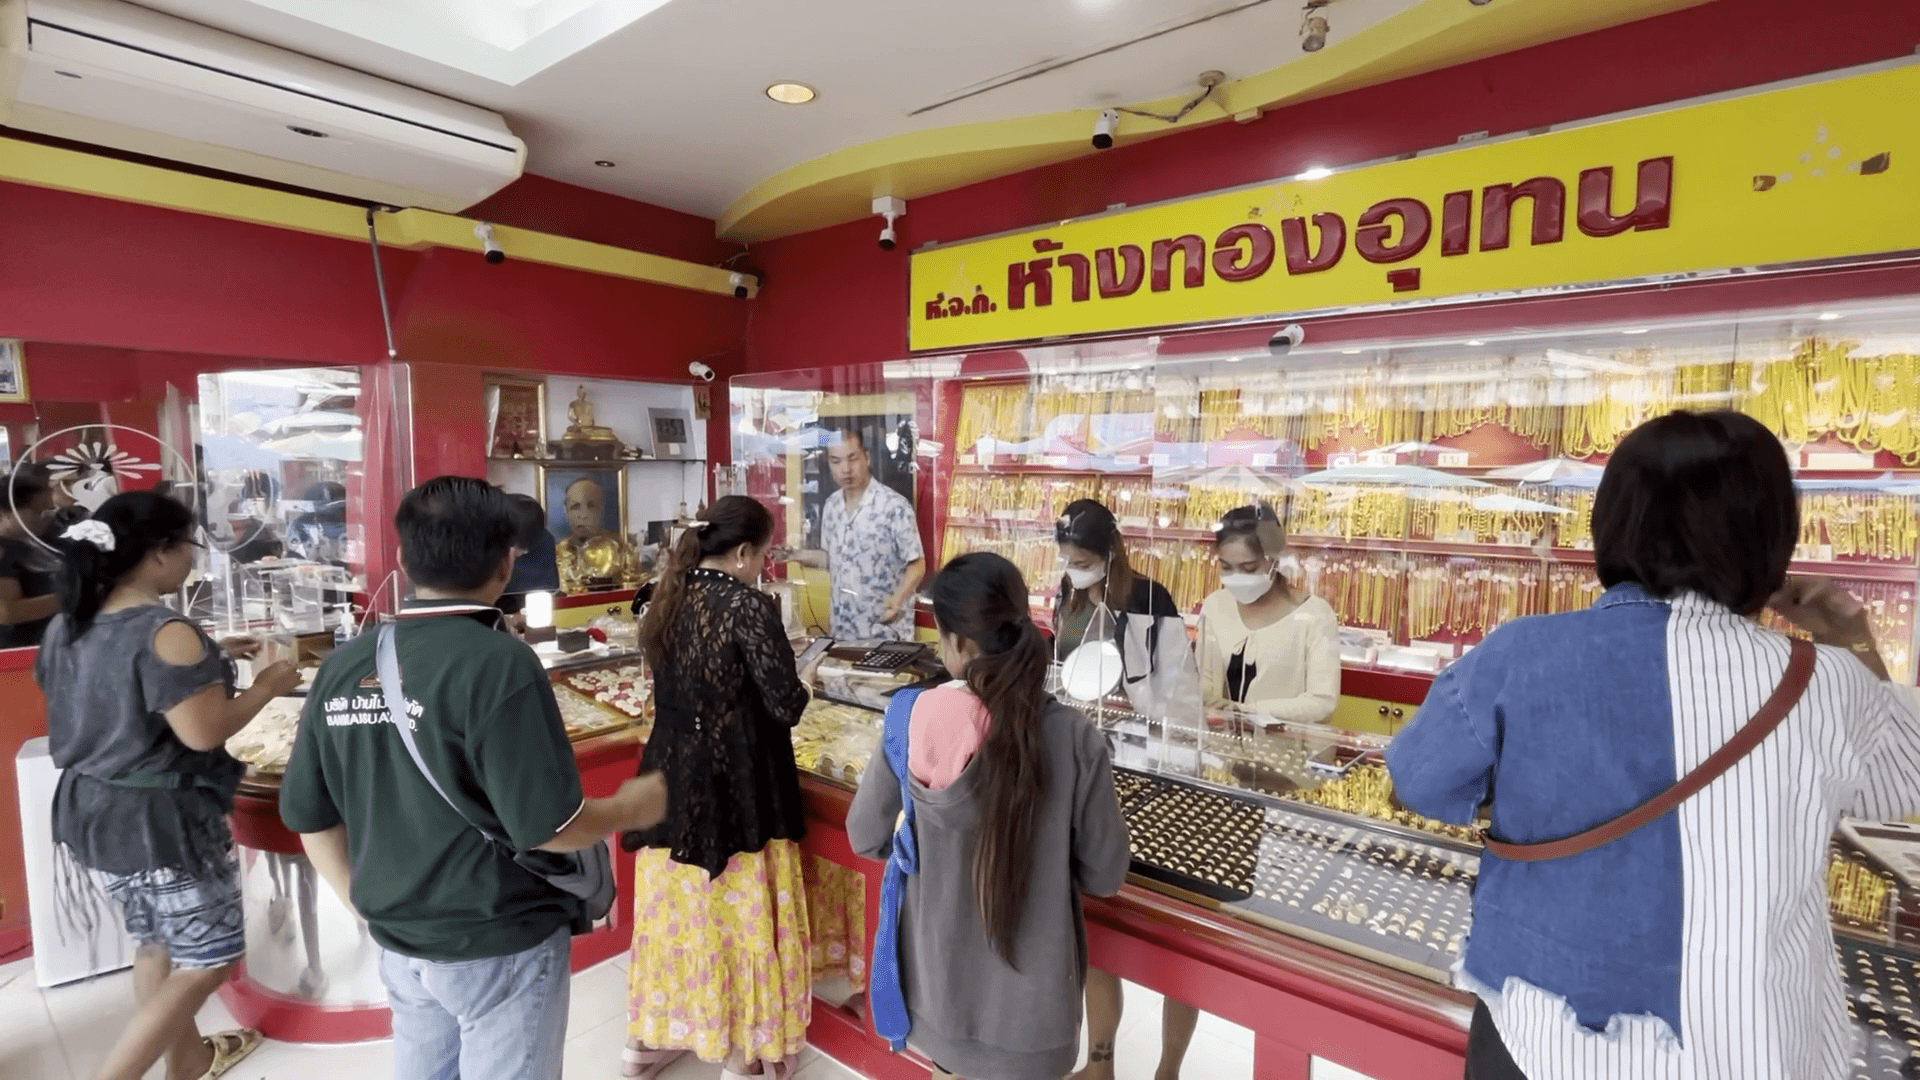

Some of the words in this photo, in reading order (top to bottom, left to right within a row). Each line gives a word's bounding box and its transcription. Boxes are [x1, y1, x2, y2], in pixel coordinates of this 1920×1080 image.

[1008, 155, 1675, 310] ห้างทองอุเทน
